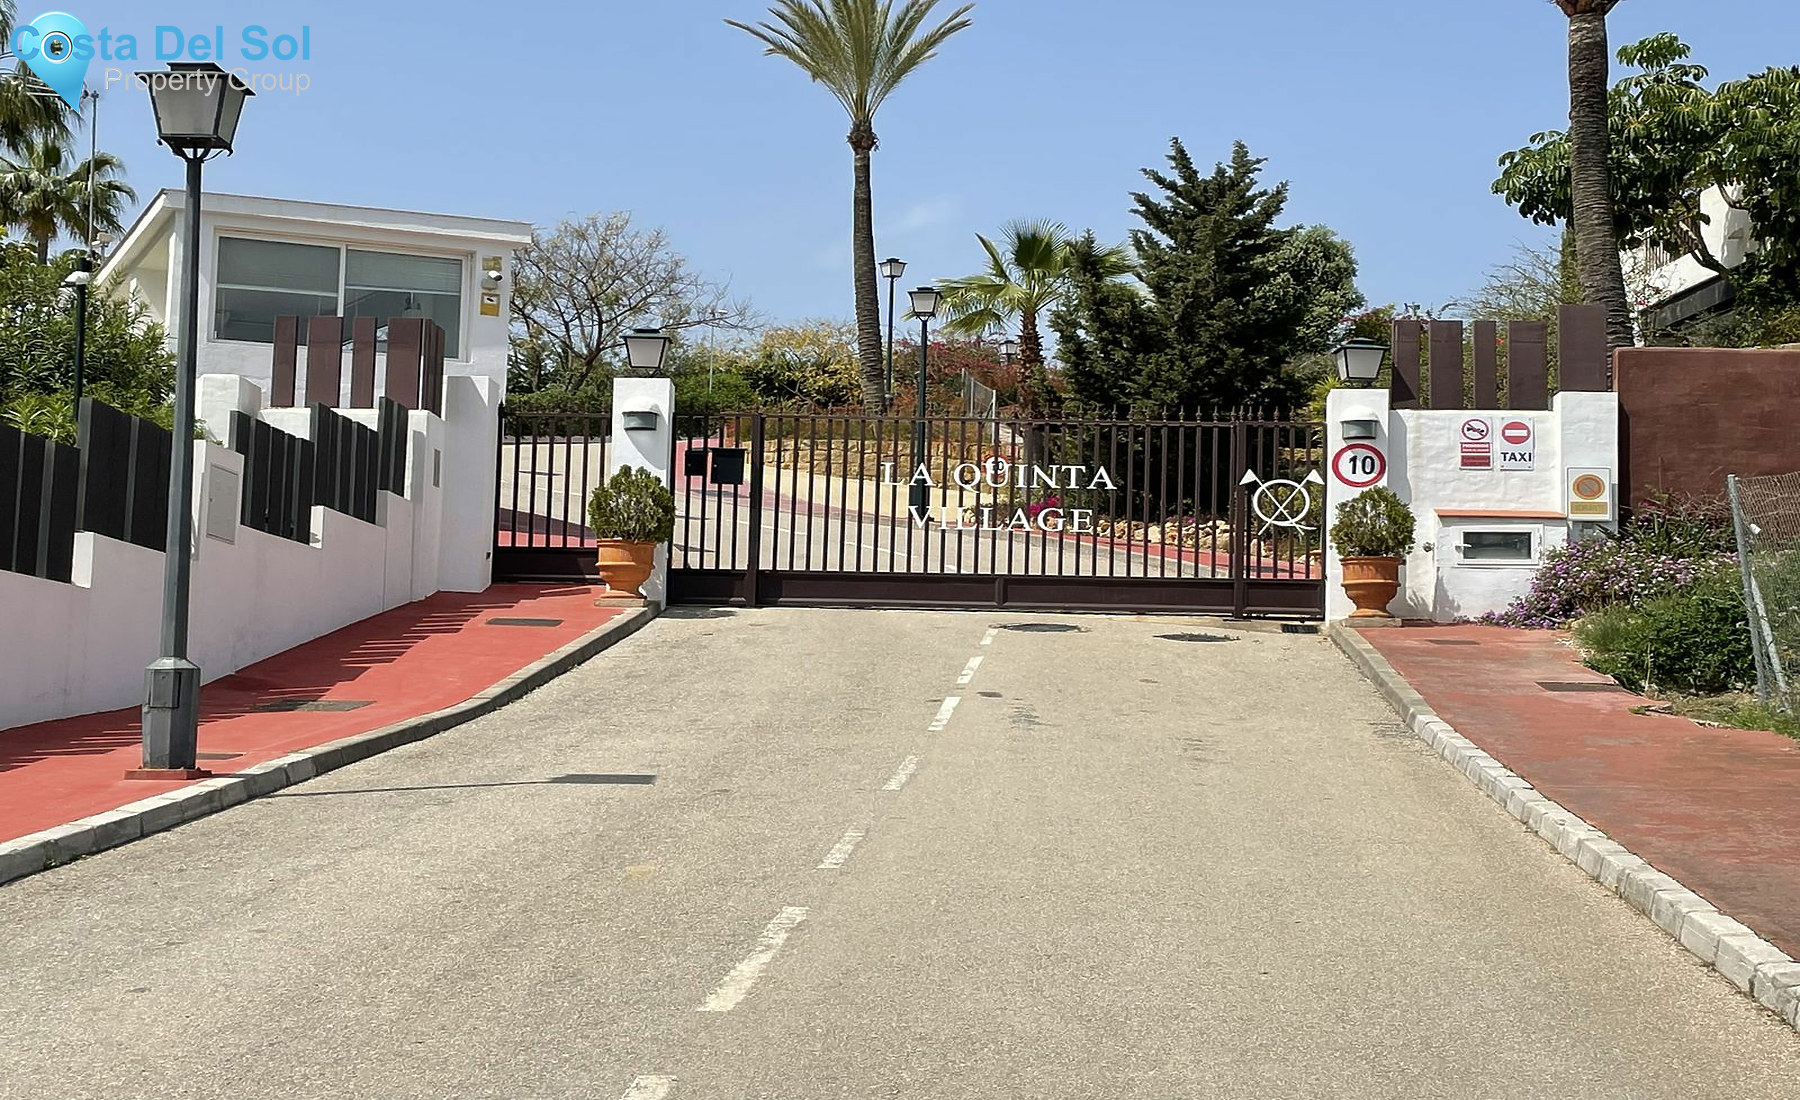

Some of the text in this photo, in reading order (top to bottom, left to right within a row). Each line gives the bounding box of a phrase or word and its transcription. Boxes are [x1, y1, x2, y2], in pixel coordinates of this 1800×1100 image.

[1349, 455, 1375, 475] 10
[1501, 452, 1532, 462] TAXI
[880, 462, 1117, 493] LA QUINTA
[908, 506, 1094, 533] VILLAGE
